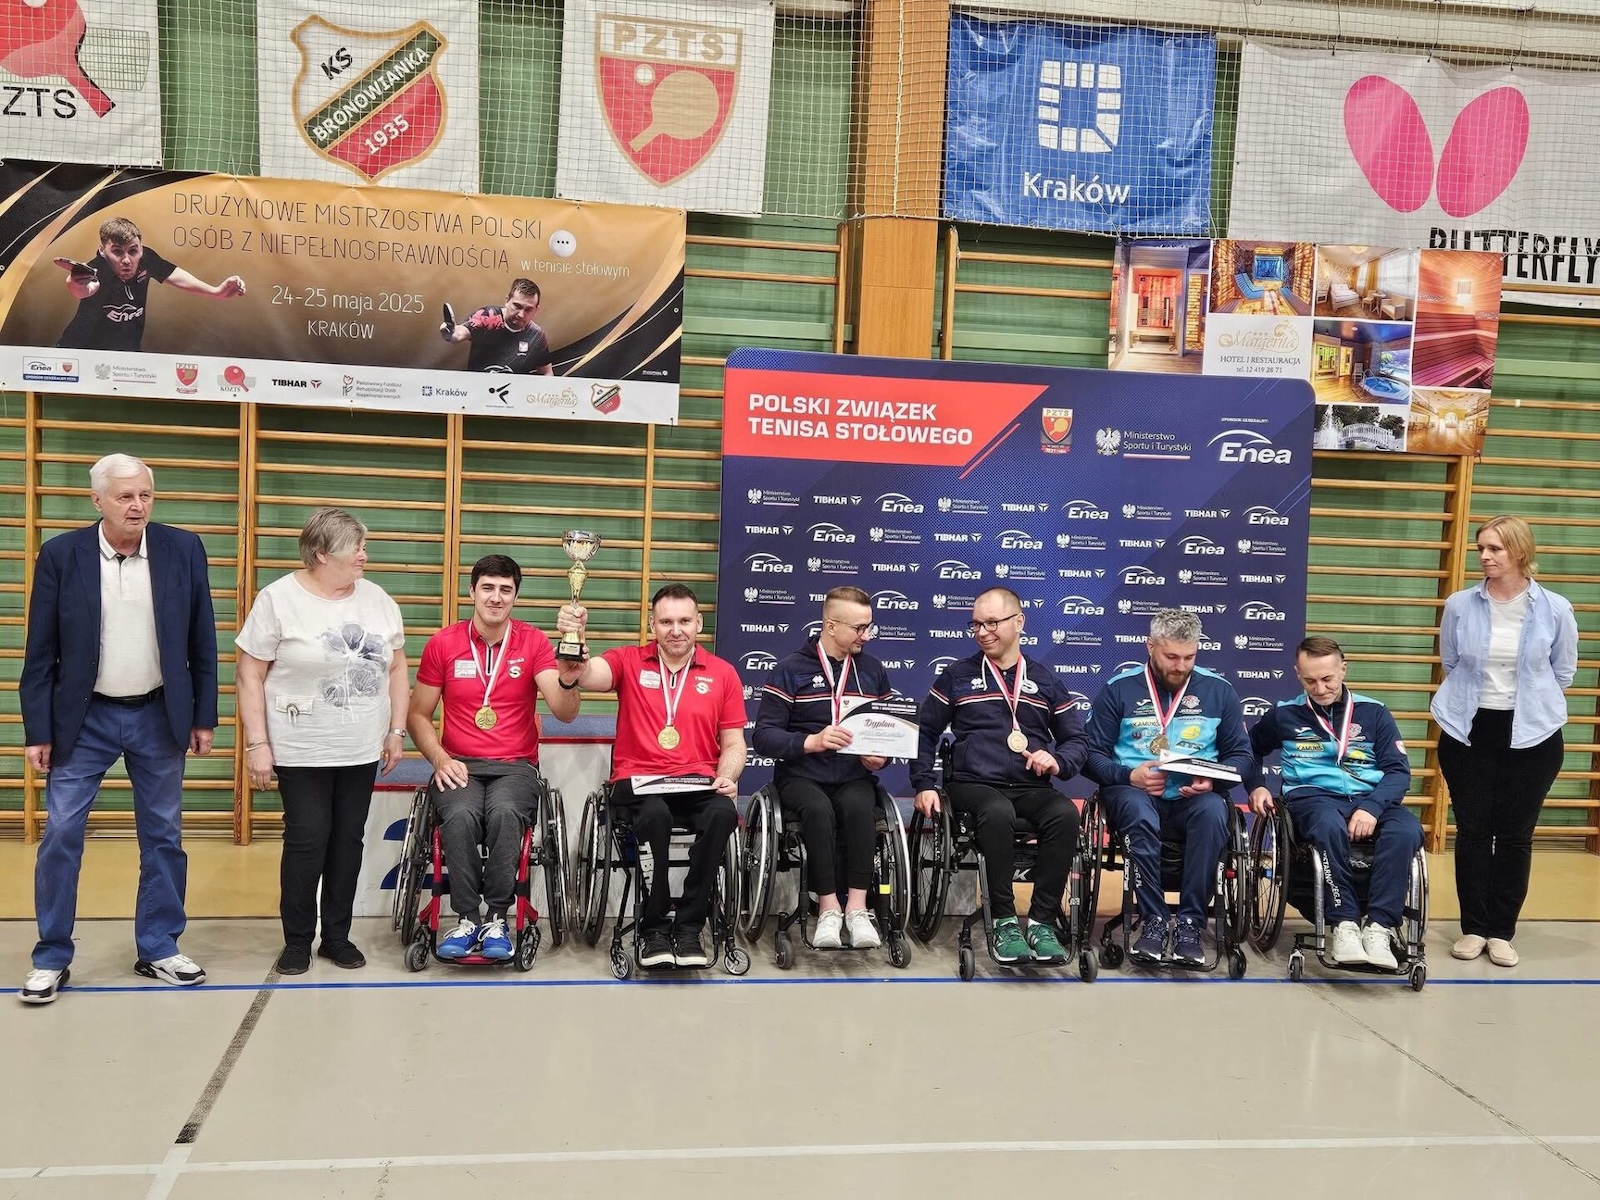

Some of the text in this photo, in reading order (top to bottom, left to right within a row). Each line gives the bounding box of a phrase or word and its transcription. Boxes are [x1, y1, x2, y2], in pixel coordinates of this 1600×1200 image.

[613, 23, 724, 61] PZTS
[320, 47, 353, 81] KS
[312, 47, 430, 141] BRONOWIANKA
[364, 114, 409, 155] 1935
[1023, 171, 1130, 204] Kraków
[174, 192, 542, 240] DRUŻYNOWE MISTRZOSTWA POLSKI
[173, 224, 510, 273] OSÓB Z NIEPEŁNOSPRAWNOŚCIĄ
[521, 257, 630, 280] w tenisie stołowym
[271, 285, 425, 317] 24-25 maja 2025
[307, 318, 375, 340] KRAKÓW
[1220, 355, 1245, 363] HOTEL
[1250, 356, 1301, 365] RESTAURACJA
[271, 379, 307, 388] TIBHAR
[435, 388, 468, 397] Kraków
[748, 392, 938, 422] POLSKI ZWIĄZEK
[747, 417, 973, 446] TENISA STOŁOWEGO
[1123, 431, 1176, 440] Ministerstwo
[1123, 442, 1150, 451] Sportu
[1156, 442, 1192, 452] Turystyki
[1219, 442, 1292, 464] Enea
[813, 496, 847, 504] TIBHAR
[882, 501, 924, 513] Enea
[1001, 504, 1035, 512] TIBHAR
[1068, 507, 1109, 519] Enea
[1185, 510, 1217, 518] TIBHAR
[1249, 513, 1289, 525] Enea
[745, 526, 779, 534] TIBHAR
[813, 530, 855, 543] Enea
[934, 533, 968, 542] TIBHAR
[1001, 537, 1043, 549] Enea
[1185, 543, 1225, 555] Enea
[751, 561, 793, 573] Enea
[872, 564, 905, 572] TIBHAR
[940, 568, 981, 579] Enea
[1125, 573, 1165, 585] Enea
[1240, 575, 1272, 583] TIBHAR
[877, 598, 919, 610] Enea
[1064, 603, 1104, 615] Enea
[1245, 609, 1285, 621] Enea
[930, 630, 962, 638] TIBHAR
[1115, 635, 1148, 643] TIBHAR
[1020, 636, 1038, 645] ea
[1198, 642, 1221, 651] nea
[746, 658, 778, 670] Ene
[1055, 665, 1087, 673] TIBHAR
[1238, 671, 1270, 679] TIBHAR
[1243, 707, 1269, 716] En
[863, 718, 896, 729] Dyplom
